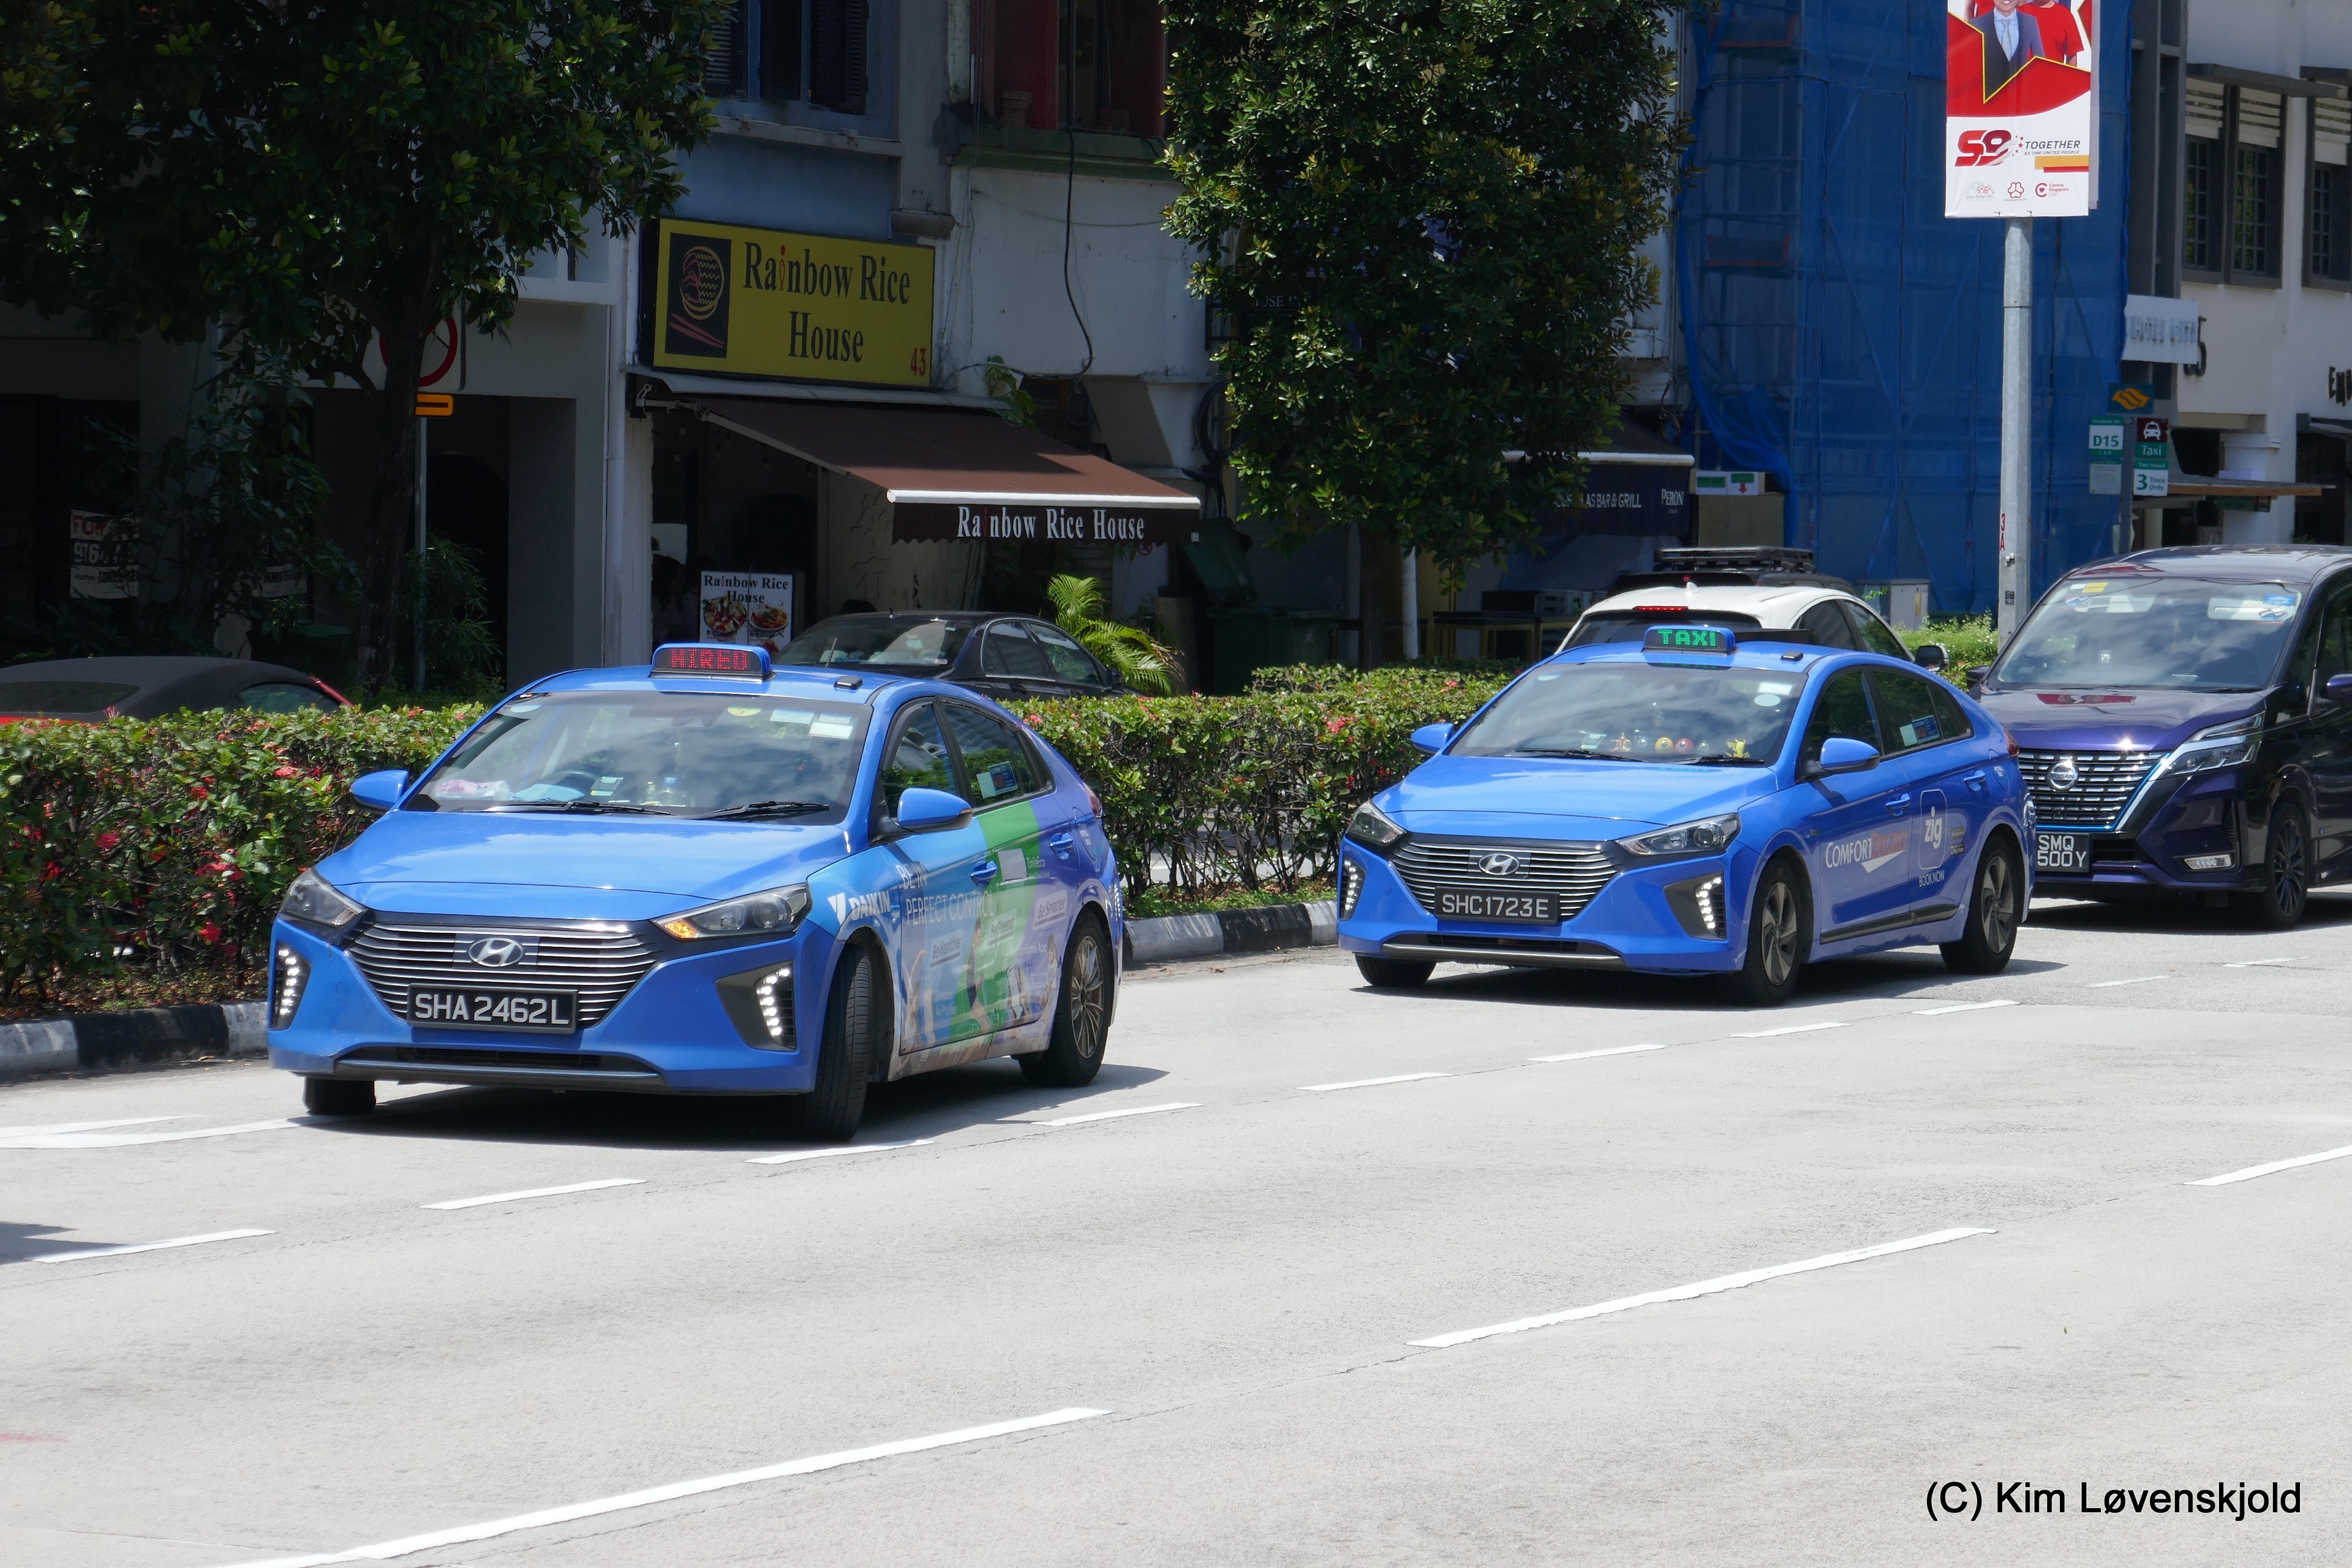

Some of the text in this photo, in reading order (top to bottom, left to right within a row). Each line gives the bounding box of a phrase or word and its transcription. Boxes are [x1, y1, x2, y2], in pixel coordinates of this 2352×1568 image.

[2025, 140, 2081, 149] TOGETHER
[743, 241, 911, 305] Rainbow Rice
[788, 311, 864, 363] House
[910, 347, 927, 377] 43
[2094, 435, 2119, 447] D15
[2142, 445, 2162, 456] Taxi
[2136, 474, 2148, 491] 3
[1596, 494, 1611, 508] BAR
[1611, 494, 1618, 508] &
[1618, 494, 1642, 508] GRILL
[1047, 508, 1084, 539] Rice
[1093, 509, 1145, 540] House
[704, 575, 788, 590] Rainbow Rice
[727, 590, 765, 603] House
[1658, 629, 1716, 646] TAXI
[672, 649, 747, 670] HIRED
[1924, 806, 1942, 849] zig
[2038, 835, 2074, 851] SMQ
[896, 864, 915, 889] BE
[1919, 870, 1945, 887] BOOK NOW
[848, 891, 891, 921] DAIKIN
[906, 890, 993, 925] PERFECT CONTROL
[1038, 897, 1065, 919] Be Smarter
[1442, 894, 1548, 918] SHC1723E
[933, 944, 939, 959] Be
[1038, 942, 1047, 956] App
[415, 993, 569, 1024] SHA2462L
